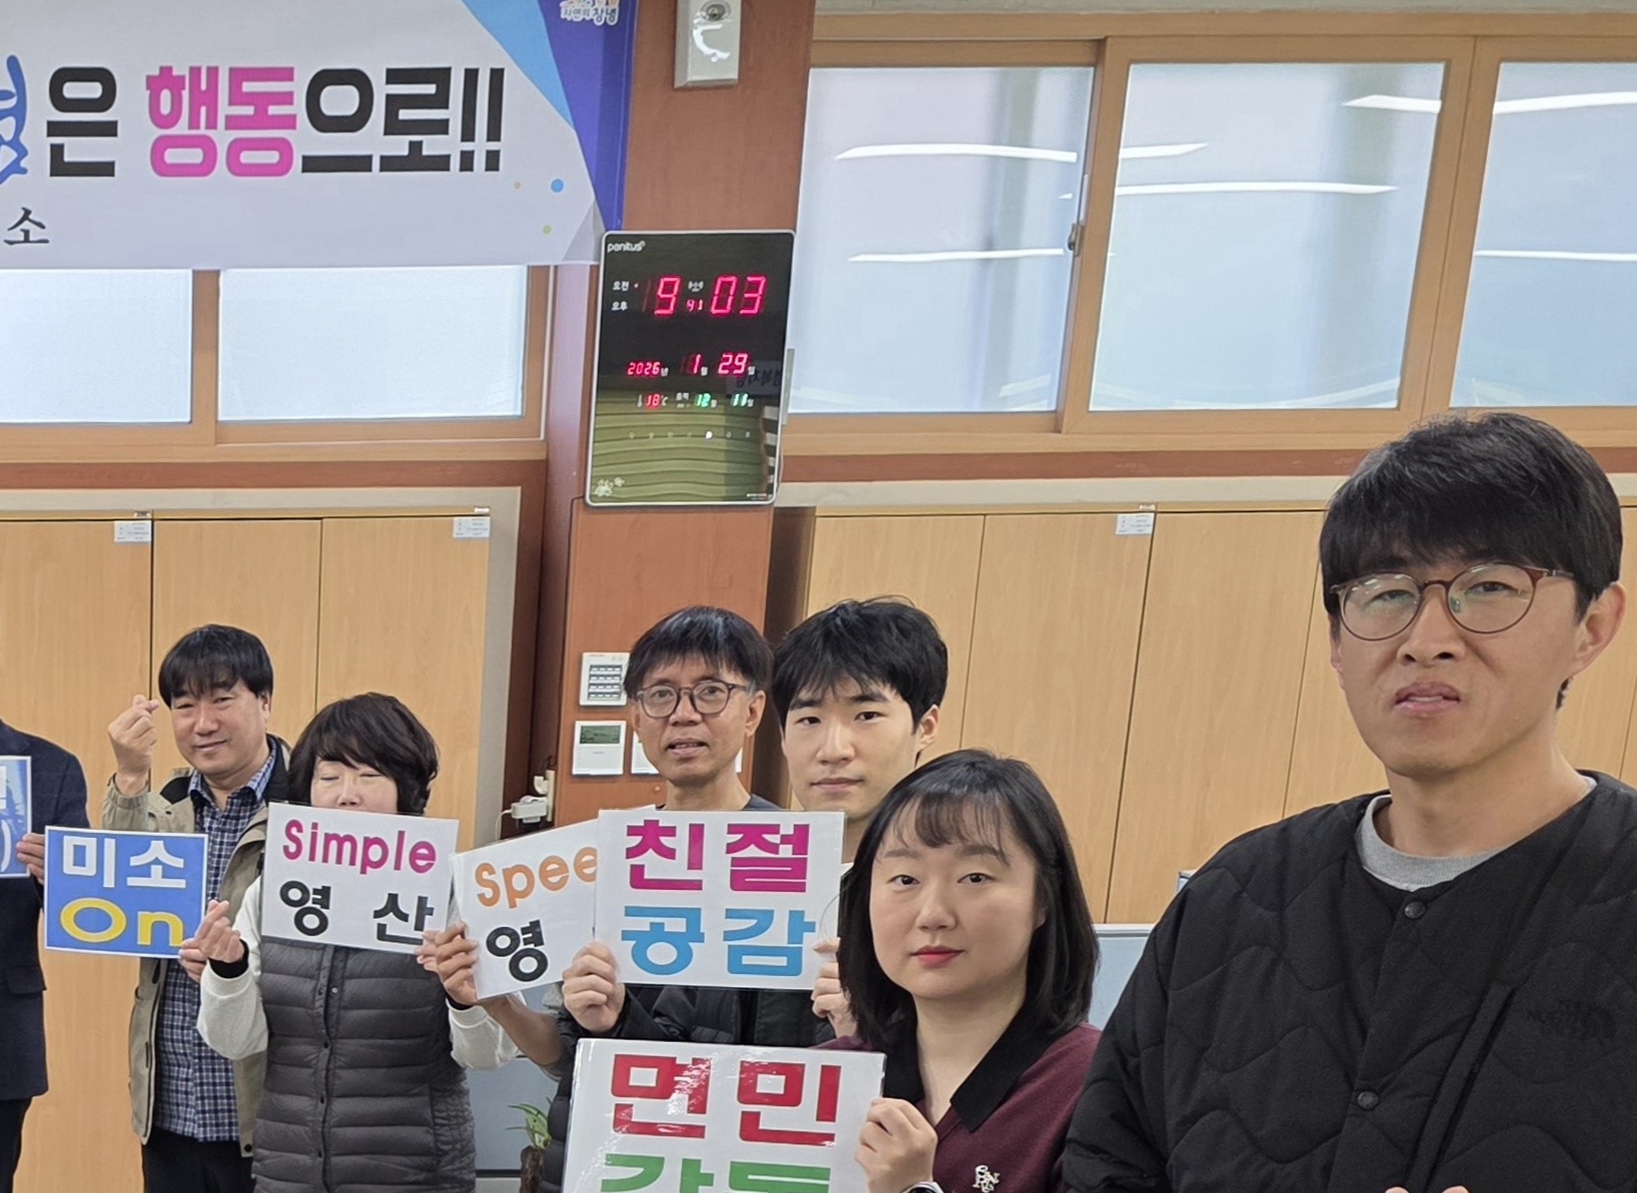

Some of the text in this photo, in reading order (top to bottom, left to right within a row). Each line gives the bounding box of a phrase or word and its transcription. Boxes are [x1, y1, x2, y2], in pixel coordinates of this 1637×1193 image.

[145, 64, 506, 178] 행동으로!!
[654, 276, 767, 315] 9 03
[62, 835, 187, 889] 미소
[282, 819, 436, 875] Simple
[475, 846, 597, 909] Spee
[625, 820, 810, 893] 친절
[60, 897, 185, 947] On
[621, 905, 816, 977] 공감
[610, 1054, 842, 1147] 면민
